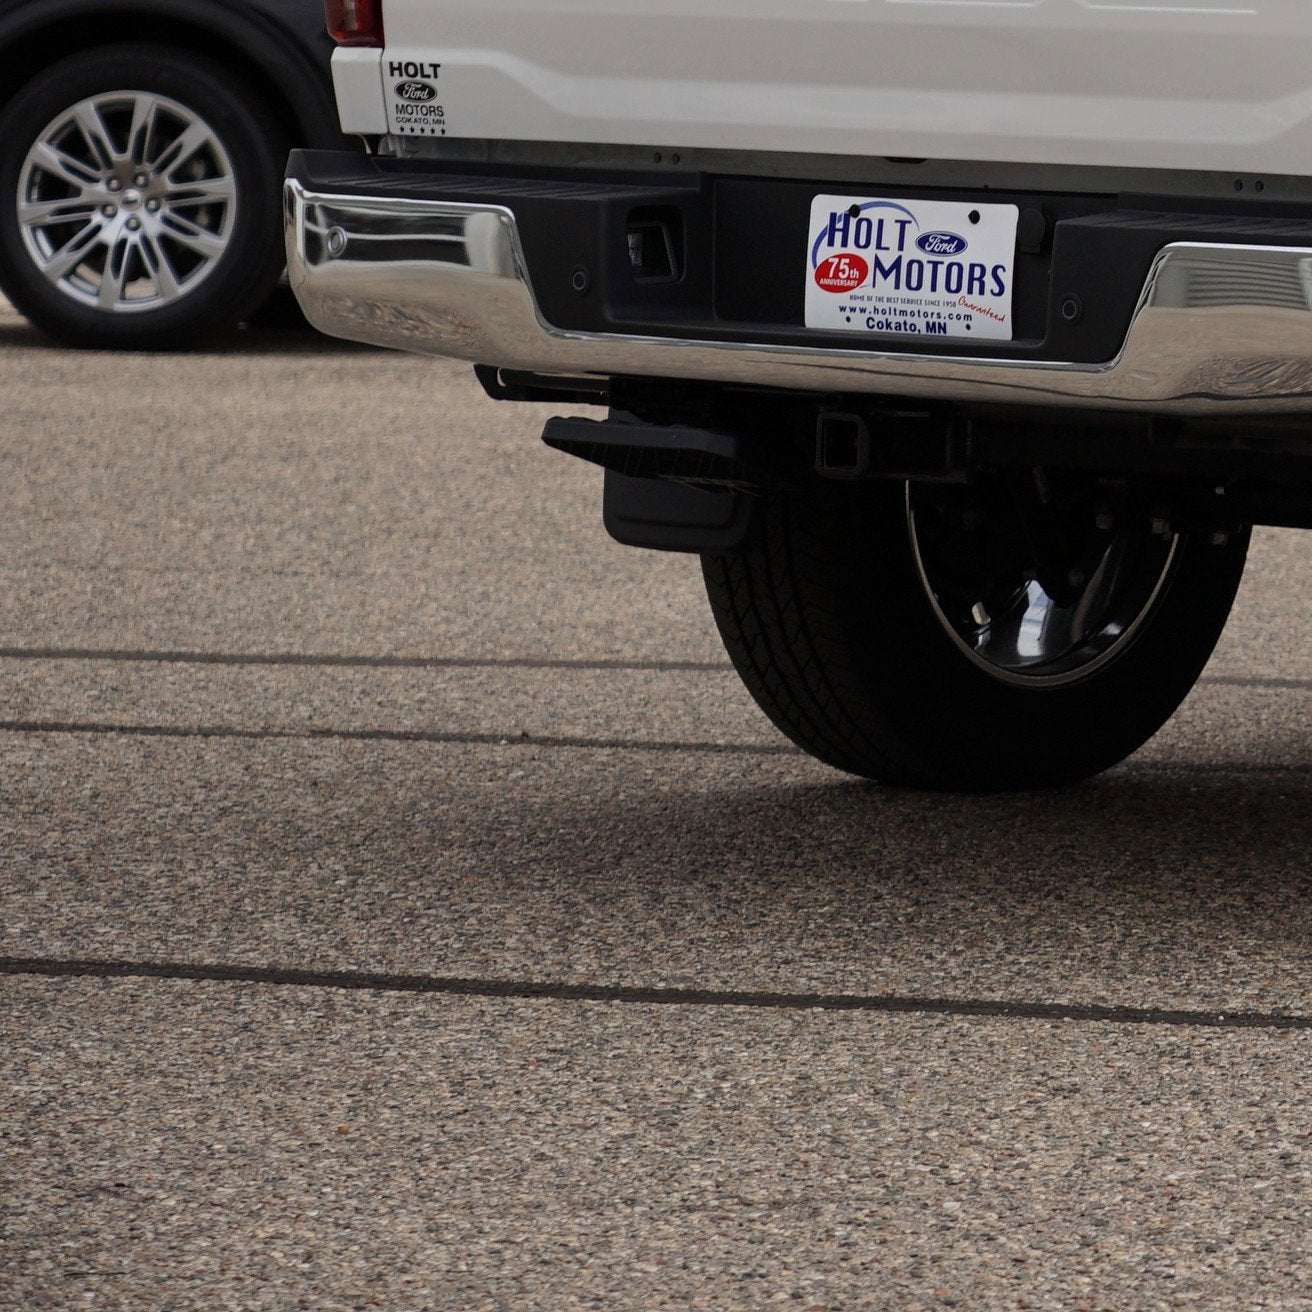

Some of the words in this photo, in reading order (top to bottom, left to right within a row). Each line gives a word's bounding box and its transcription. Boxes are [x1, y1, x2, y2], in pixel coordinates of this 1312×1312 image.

[388, 61, 441, 79] HOLT
[402, 83, 429, 100] Ford
[395, 103, 444, 117] MOTORS
[826, 211, 912, 252] HOLT
[924, 233, 959, 254] Ford
[828, 257, 859, 279] 75th
[872, 253, 1007, 298] MOTORS
[819, 278, 859, 288] ANNIVERSARY
[849, 294, 866, 302] HOME
[924, 299, 940, 307] SINCE
[838, 304, 973, 322] www.holtmotors.com
[866, 316, 921, 335] Cokato,
[925, 319, 948, 335] MN
